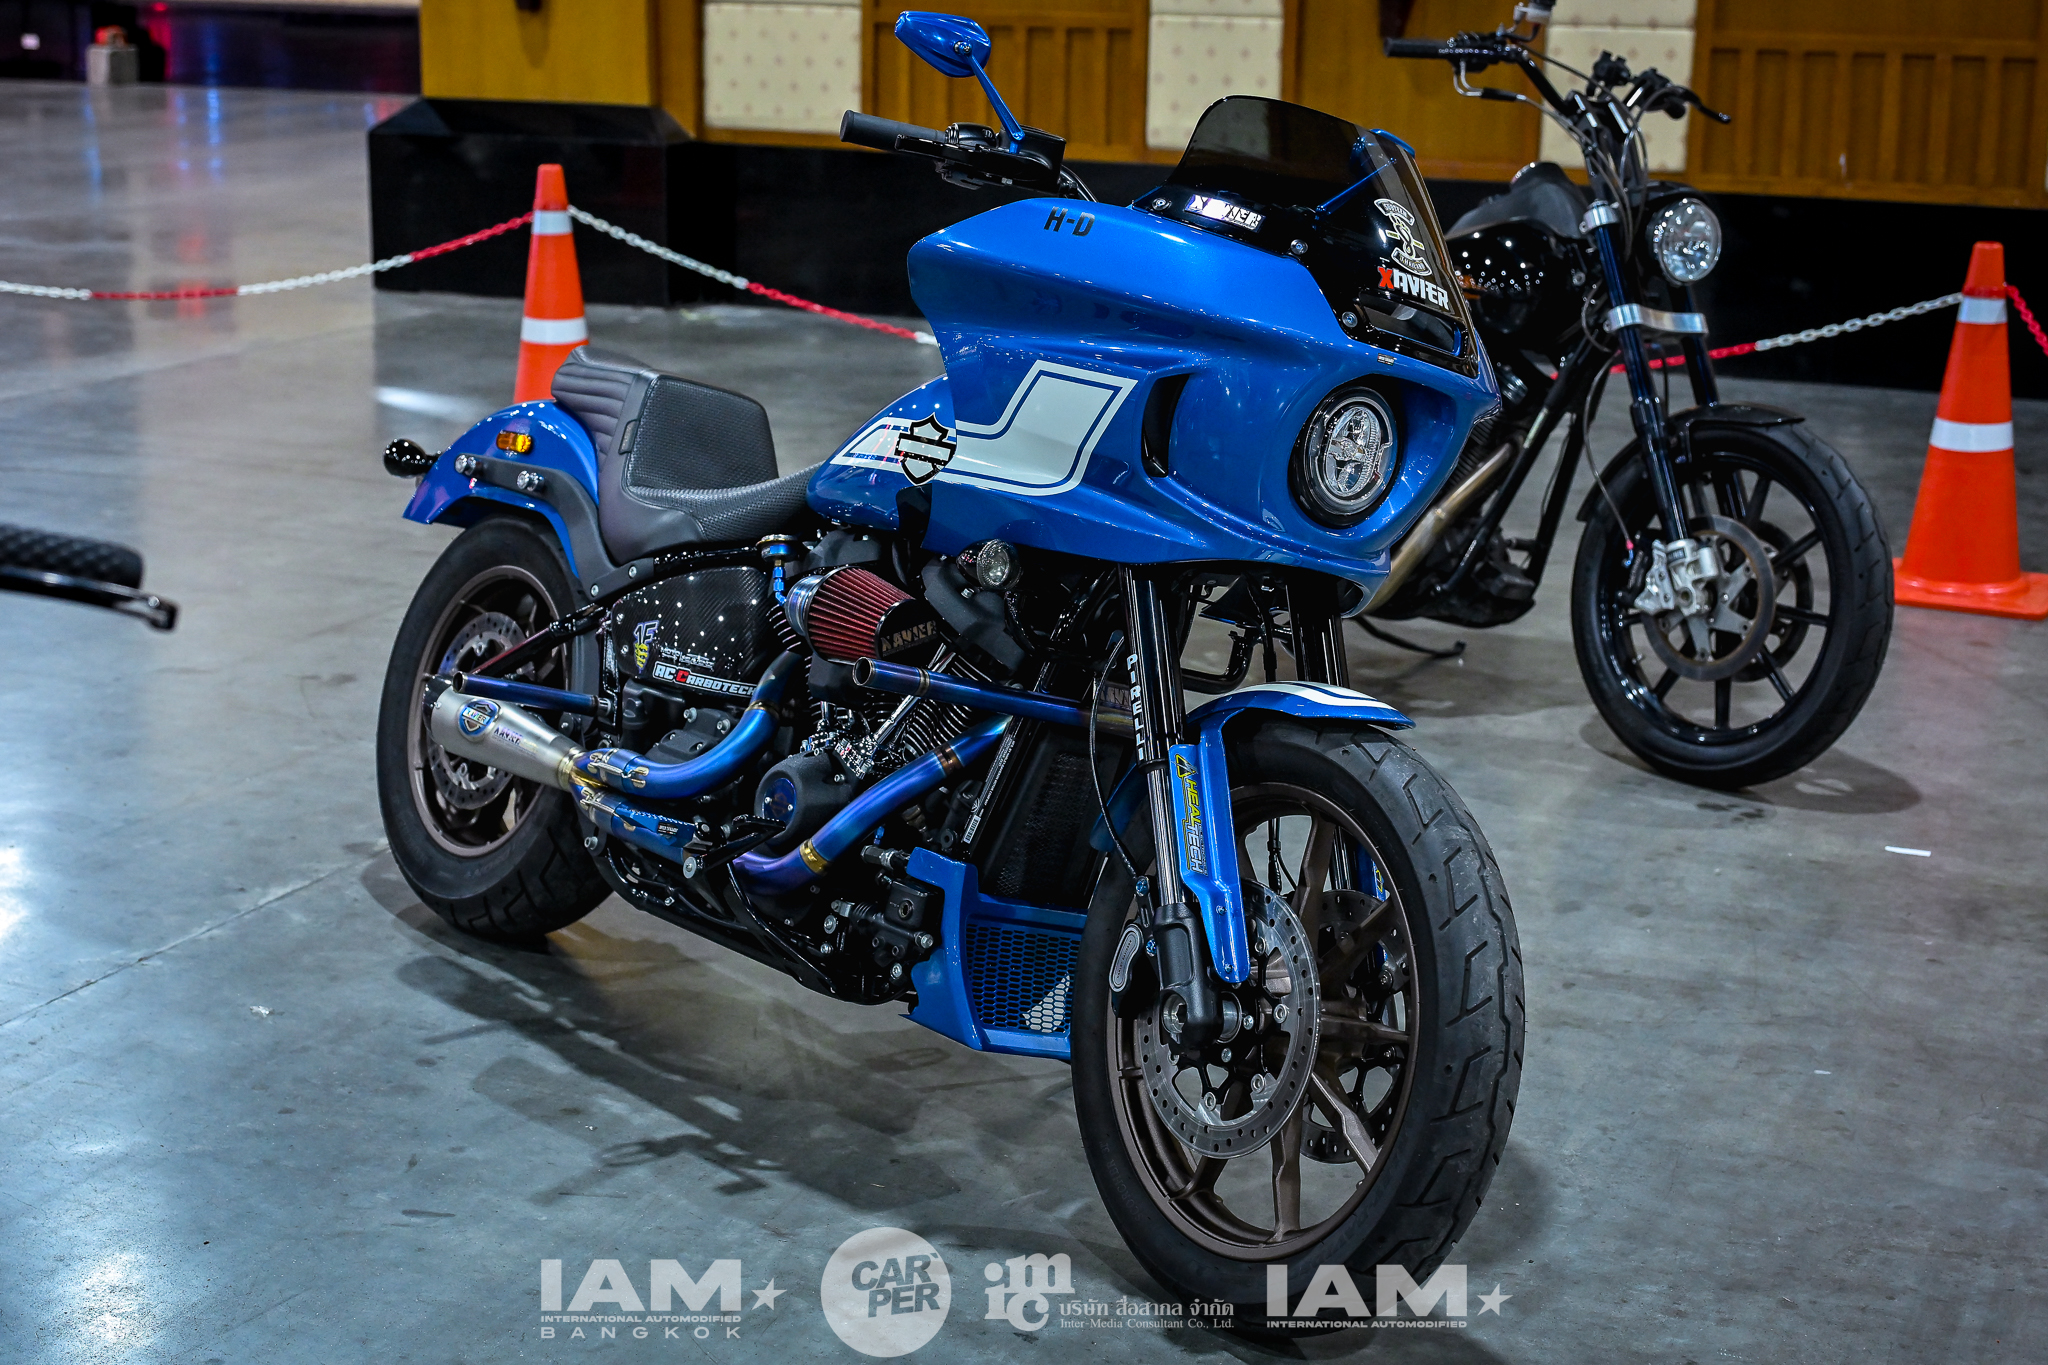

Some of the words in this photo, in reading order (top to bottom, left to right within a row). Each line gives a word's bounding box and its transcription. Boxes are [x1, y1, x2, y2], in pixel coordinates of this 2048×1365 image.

[1044, 206, 1095, 237] H-D
[1378, 266, 1449, 310] XAVIER
[1126, 653, 1145, 761] PIRELLI
[1186, 778, 1205, 874] HEALTECH
